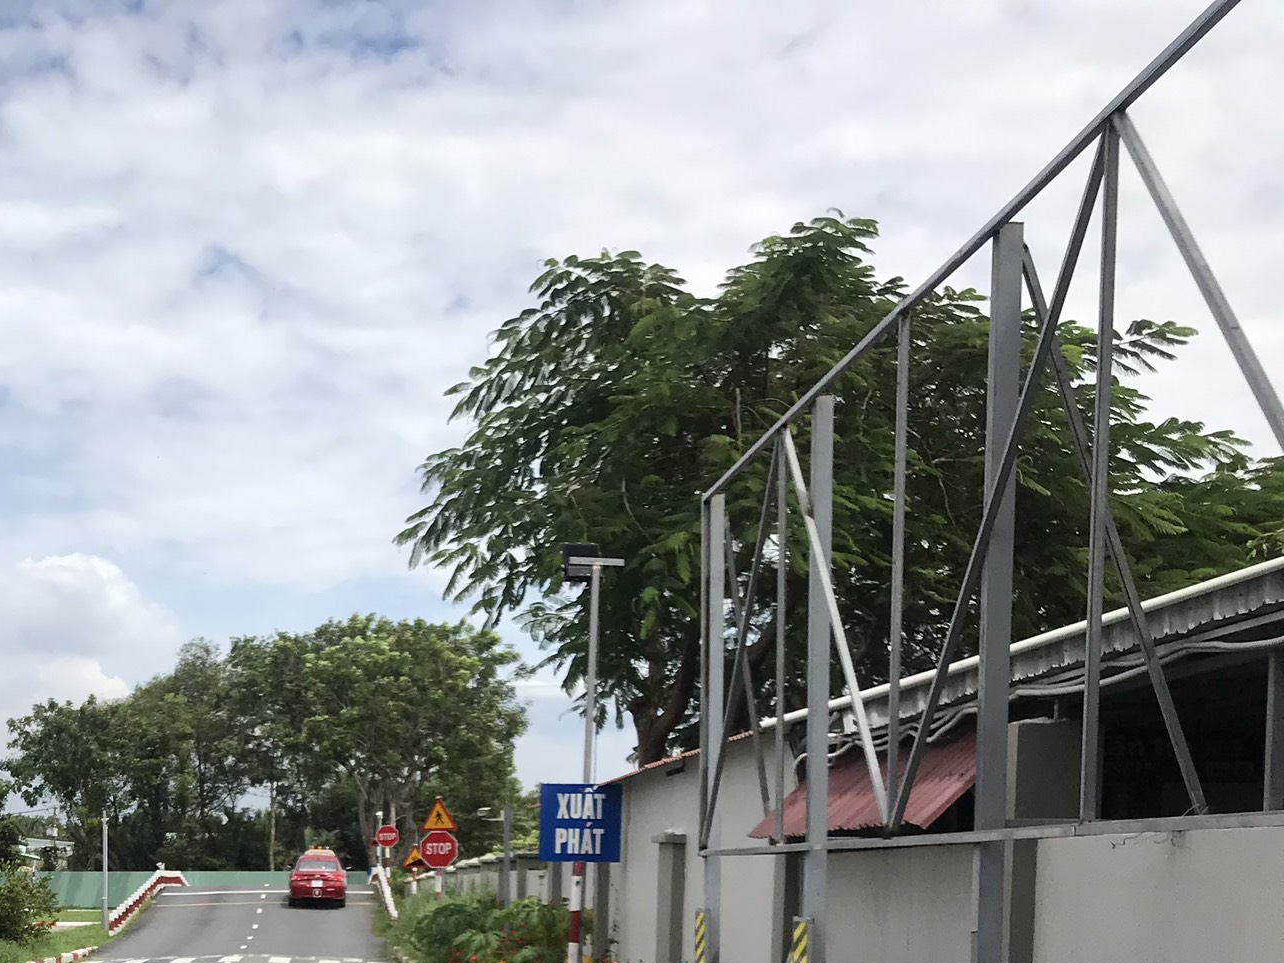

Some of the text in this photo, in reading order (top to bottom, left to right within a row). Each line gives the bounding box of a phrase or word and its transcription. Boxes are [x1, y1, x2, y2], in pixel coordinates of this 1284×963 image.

[556, 785, 606, 819] XUẤT
[379, 832, 396, 841] STOP
[554, 821, 605, 854] PHÁT
[425, 842, 452, 855] STOP
